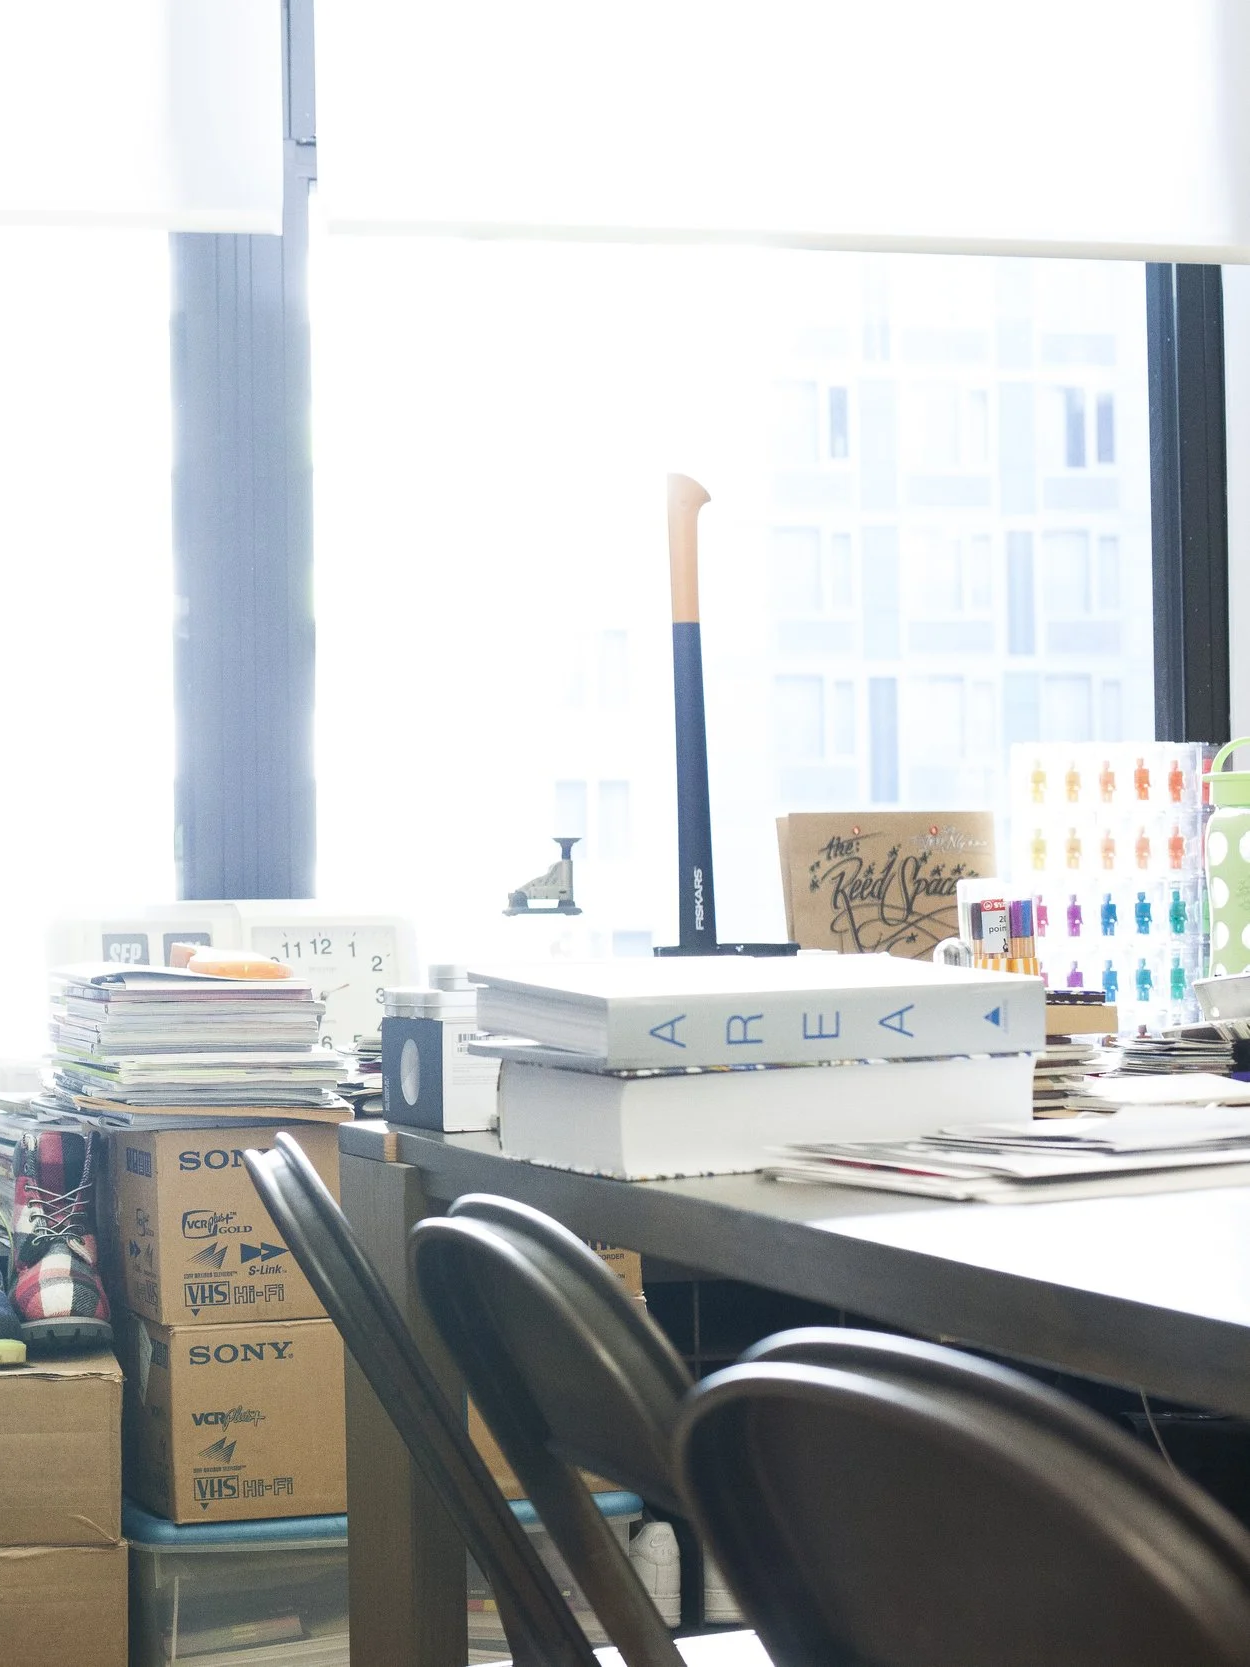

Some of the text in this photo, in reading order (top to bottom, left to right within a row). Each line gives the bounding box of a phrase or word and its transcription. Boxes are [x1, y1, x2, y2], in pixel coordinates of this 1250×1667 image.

[694, 866, 705, 931] FISKARS
[282, 941, 301, 958] 11
[310, 938, 332, 954] 12
[348, 941, 356, 957] 1
[371, 955, 383, 972] 2
[375, 987, 385, 1004] 3
[321, 1035, 333, 1050] 6
[178, 1148, 269, 1171] SON
[219, 1225, 253, 1235] GOLD
[187, 1283, 285, 1305] VHS Hi-Fi
[189, 1341, 293, 1366] SONY
[196, 1477, 294, 1499] VHS Hi-Fi
